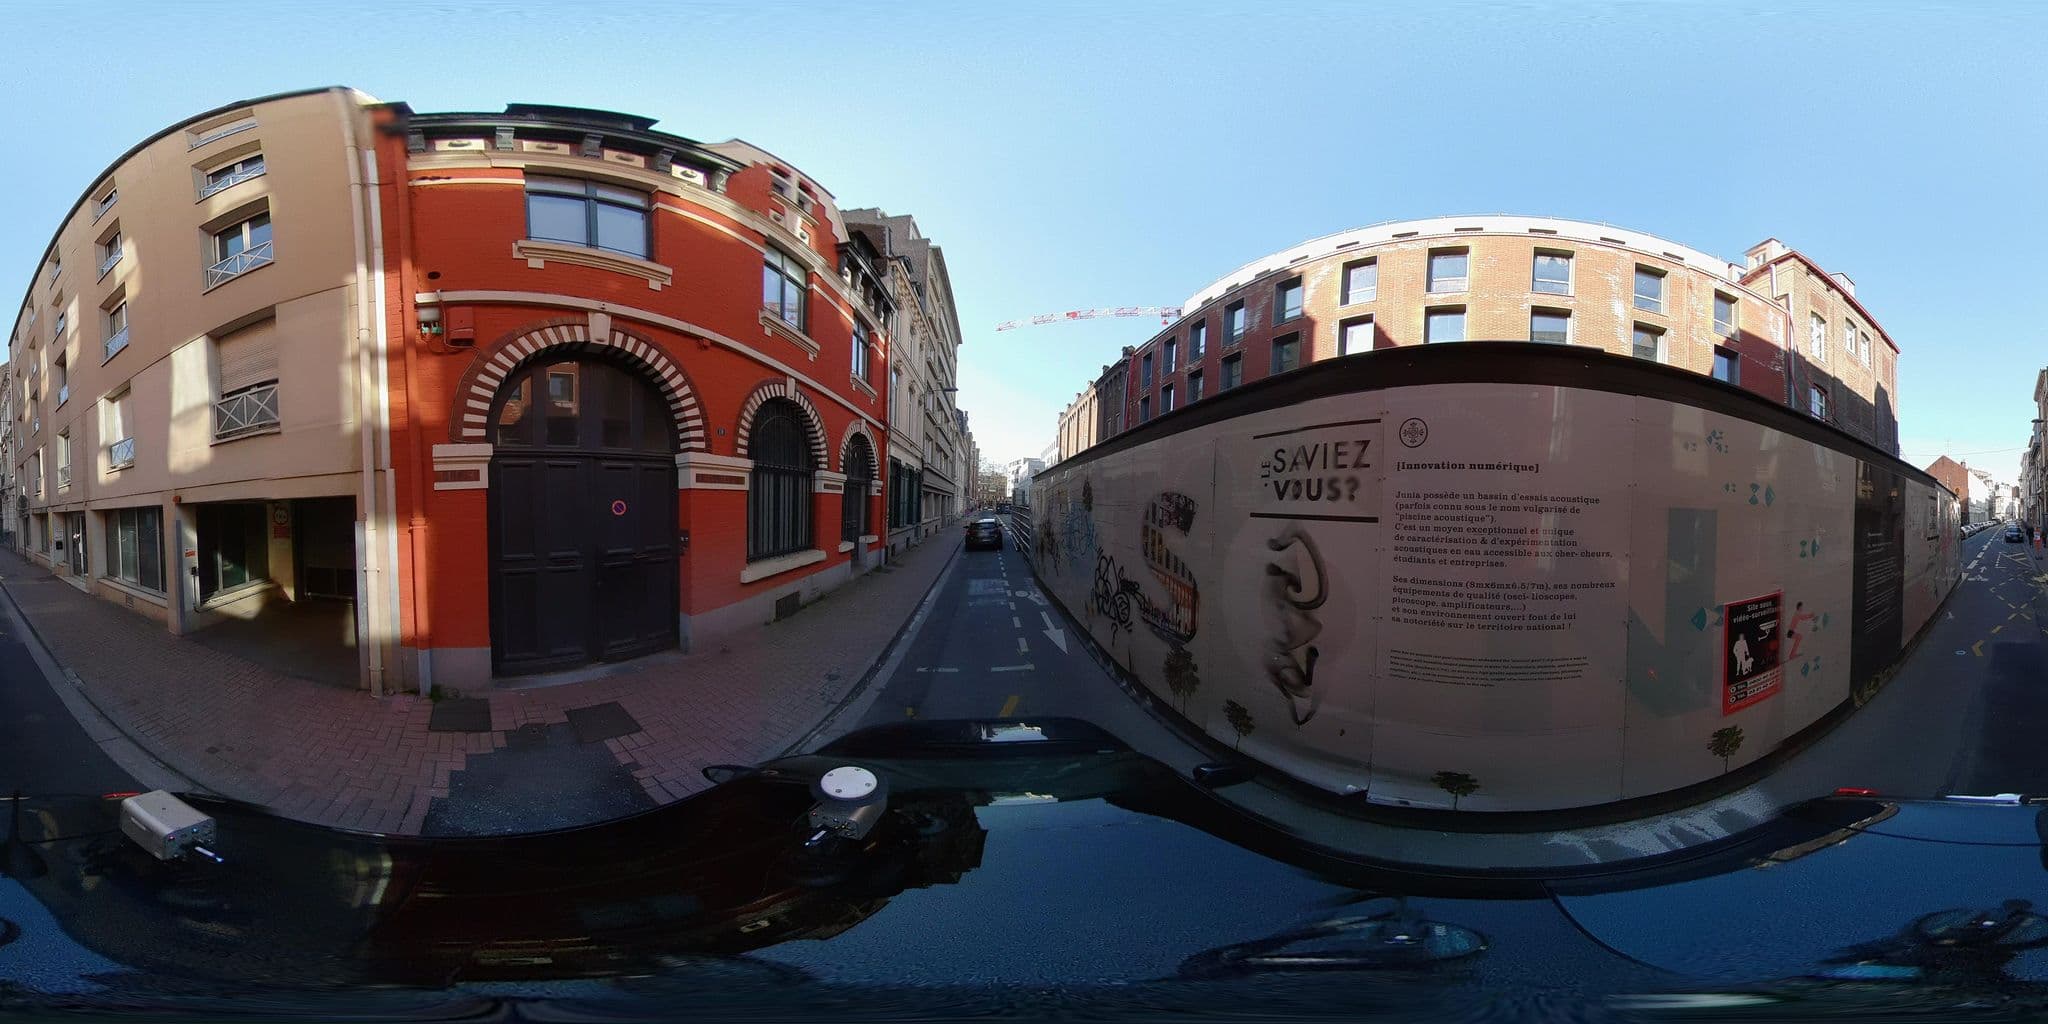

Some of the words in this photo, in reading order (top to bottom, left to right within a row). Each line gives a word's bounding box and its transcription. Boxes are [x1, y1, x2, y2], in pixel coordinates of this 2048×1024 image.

[1273, 440, 1371, 473] SAVIEZ
[1396, 461, 1465, 472] [Innovation
[1469, 461, 1539, 474] numérique]
[1273, 476, 1360, 502] VOUS?
[1423, 491, 1460, 501] possède
[1477, 492, 1508, 501] bassin
[1511, 493, 1548, 502] d'essais
[1550, 495, 1600, 505] acoustique
[1433, 503, 1462, 511] connu
[1489, 503, 1498, 512] le
[1569, 506, 1581, 514] de
[1433, 526, 1464, 534] moyen
[1466, 526, 1527, 535] exceptionnel
[1542, 528, 1575, 537] unique
[1407, 535, 1478, 545] caractérisation
[1480, 537, 1488, 545] &
[1491, 537, 1577, 547] d'expérimentation
[1394, 545, 1448, 555] acoustiques
[1464, 548, 1481, 556] eau
[1483, 548, 1532, 557] accessible
[1393, 554, 1436, 565] étudiants
[1392, 575, 1408, 583] Ses
[1410, 576, 1463, 588] dimensions
[1570, 581, 1616, 589] nombreux
[1392, 585, 1450, 597] équipements
[1453, 590, 1464, 598] de
[1466, 592, 1501, 600] qualité
[1420, 609, 1492, 620] environnement
[1403, 617, 1445, 627] notoriété
[1466, 622, 1474, 630] le
[1477, 623, 1523, 631] territoire
